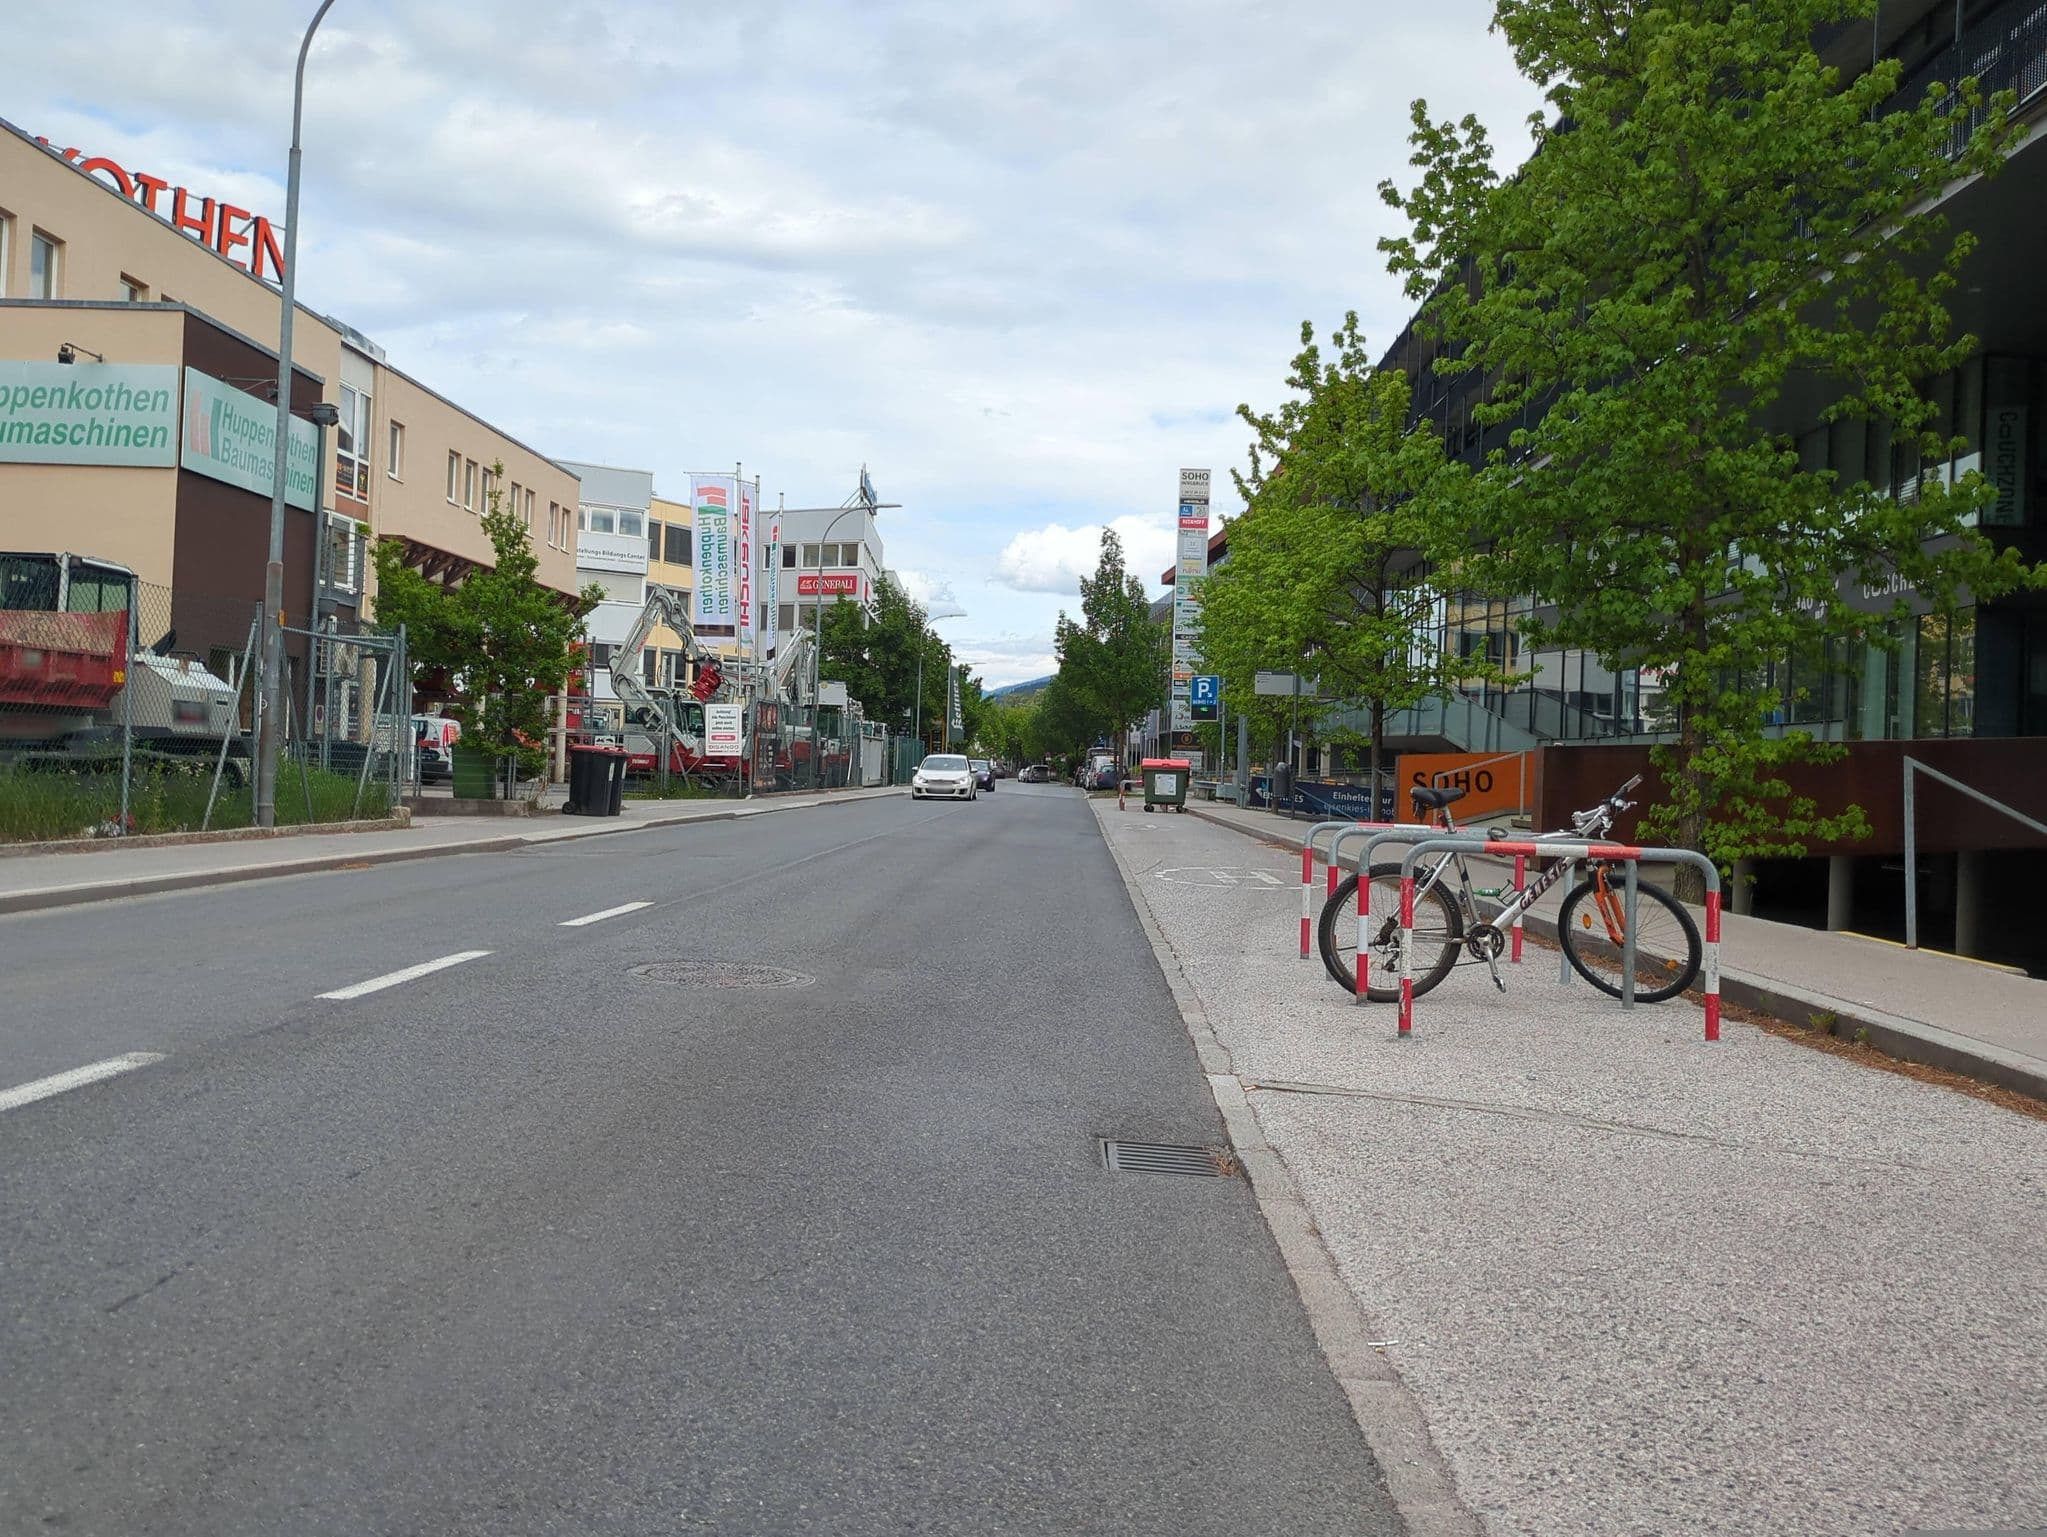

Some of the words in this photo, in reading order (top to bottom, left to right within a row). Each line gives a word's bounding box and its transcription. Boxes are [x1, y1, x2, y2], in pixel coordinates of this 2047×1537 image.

[222, 402, 316, 465] Huppenthen
[220, 437, 314, 495] Baumasinen
[1182, 472, 1208, 480] SOHO
[627, 552, 645, 560] Center
[1198, 682, 1209, 698] P
[1413, 770, 1494, 793] SOHO
[1520, 857, 1568, 909] GENESIS
